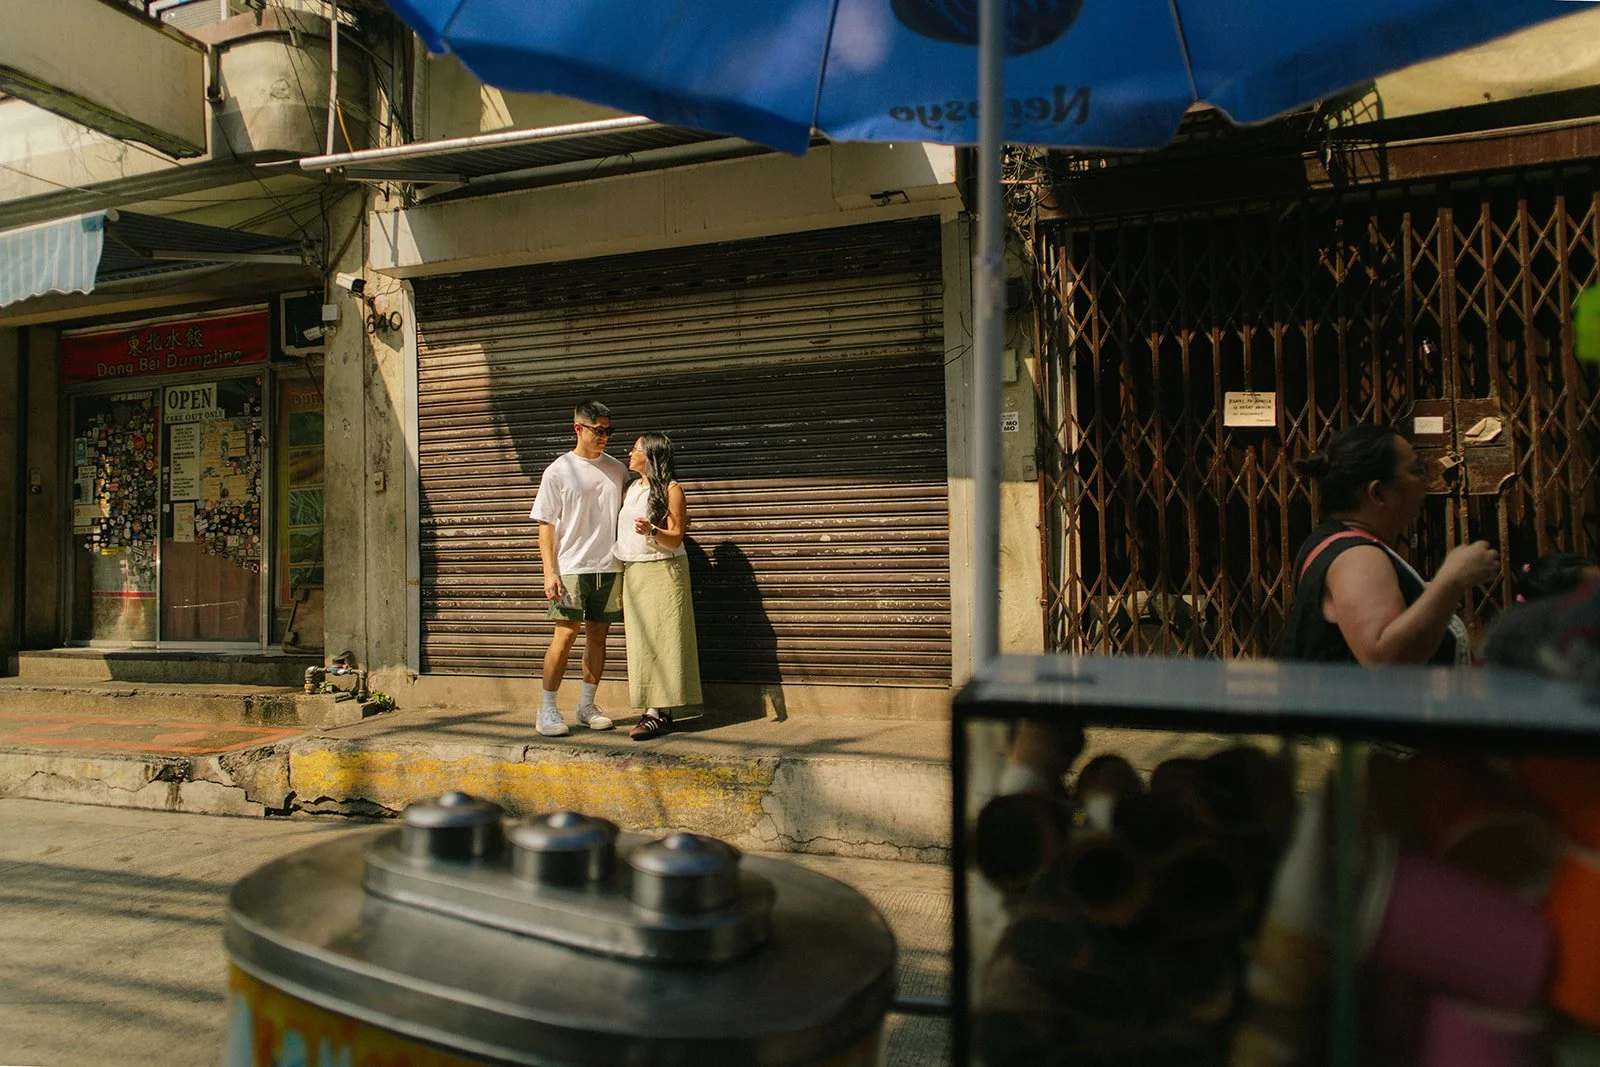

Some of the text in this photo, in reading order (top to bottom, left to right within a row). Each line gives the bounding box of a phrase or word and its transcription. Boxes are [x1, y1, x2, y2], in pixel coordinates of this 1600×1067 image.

[366, 311, 403, 335] 640
[127, 326, 204, 356] 東北水餃
[97, 350, 241, 376] Dong Bei Dumpling
[168, 387, 213, 410] OPEN
[166, 409, 223, 422] TAKE OUT ONLY
